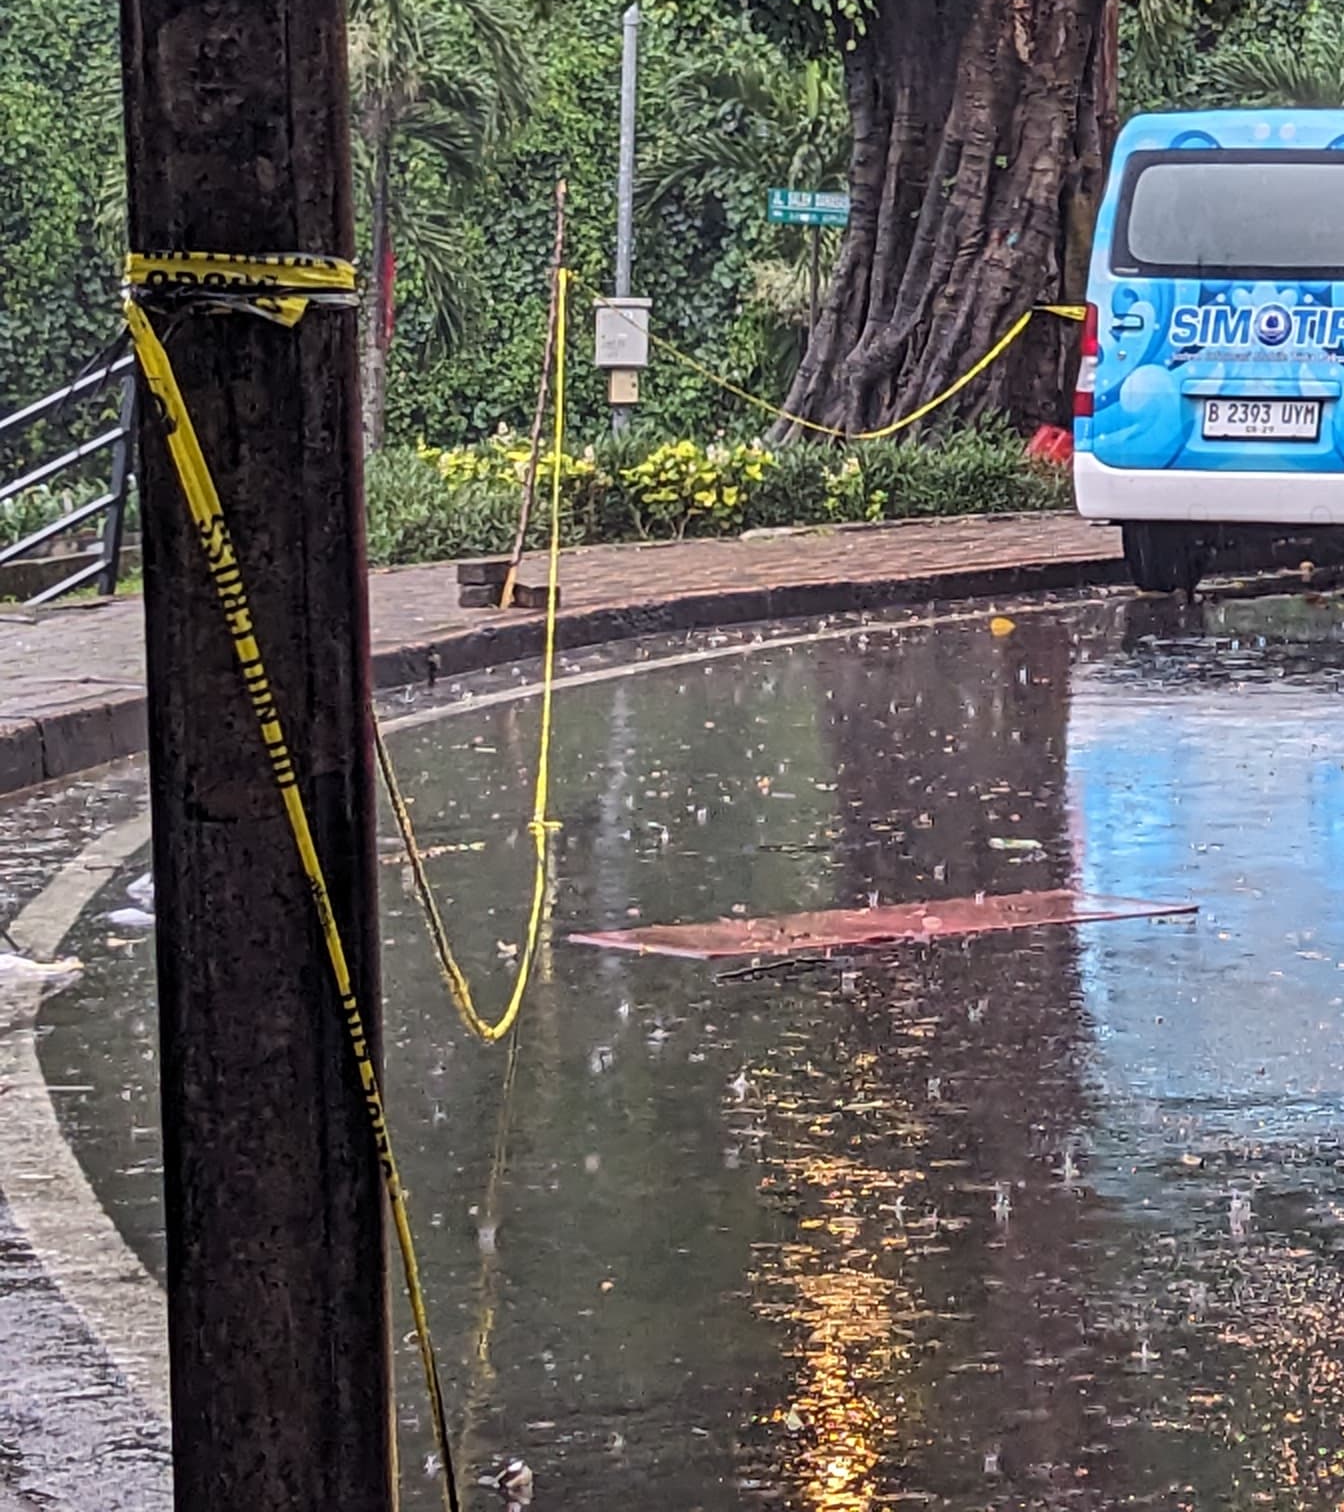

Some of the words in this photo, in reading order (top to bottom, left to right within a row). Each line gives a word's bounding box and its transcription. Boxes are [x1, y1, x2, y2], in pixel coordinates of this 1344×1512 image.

[1207, 402, 1220, 424] B
[1227, 403, 1272, 425] 2393
[1281, 404, 1315, 426] UYM
